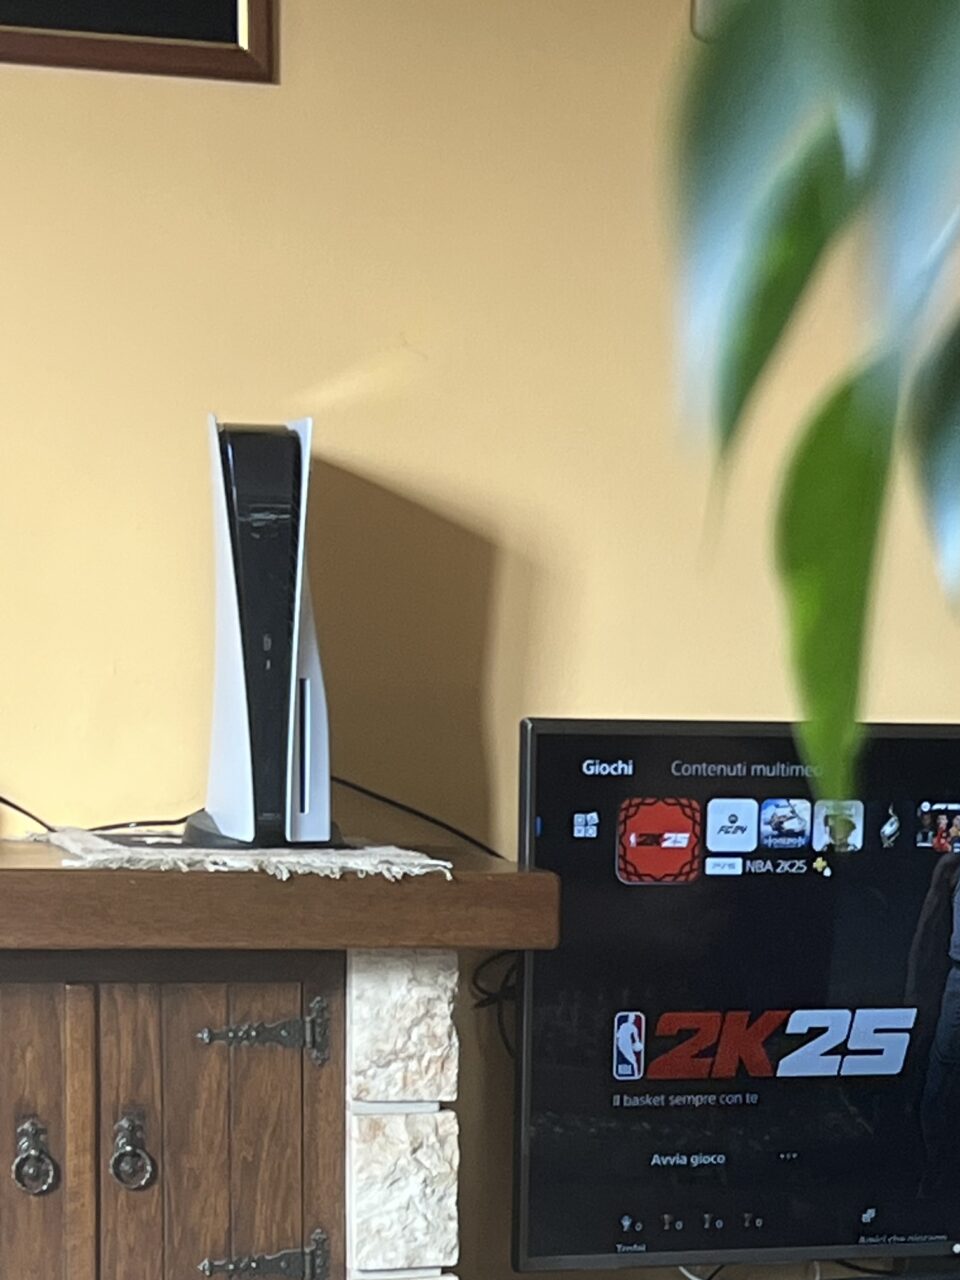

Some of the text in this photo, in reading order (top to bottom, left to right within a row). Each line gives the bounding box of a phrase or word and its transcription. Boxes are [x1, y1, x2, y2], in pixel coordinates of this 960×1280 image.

[582, 759, 634, 777] Giochi
[671, 760, 747, 777] Contenuti
[745, 859, 808, 873] NBA 2K25
[646, 1007, 918, 1080] 2K25
[623, 1094, 666, 1107] basket
[668, 1094, 717, 1108] sempre
[719, 1094, 743, 1105] con
[745, 1092, 759, 1105] te
[650, 1152, 726, 1168] Avvia gioco
